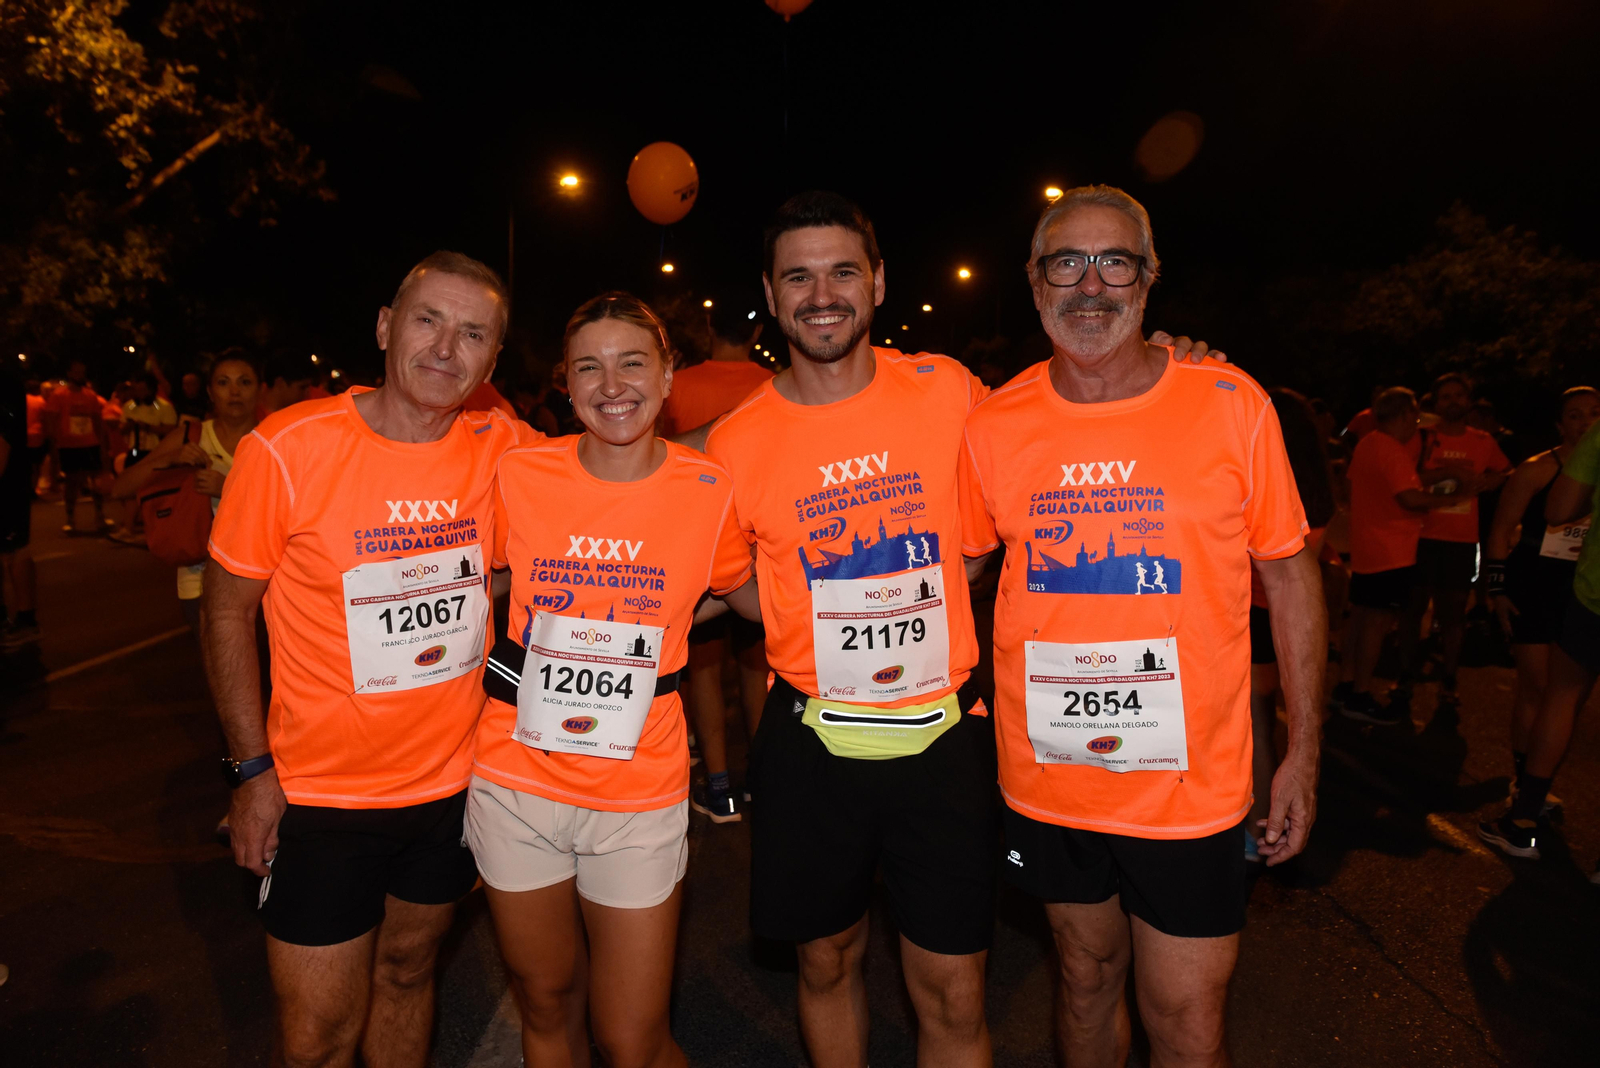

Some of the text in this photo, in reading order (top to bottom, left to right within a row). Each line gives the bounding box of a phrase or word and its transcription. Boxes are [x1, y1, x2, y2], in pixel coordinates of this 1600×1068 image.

[818, 451, 888, 487] XXXV
[1059, 460, 1136, 486] XXXV
[795, 472, 921, 508] CARRERA NOCTURNA
[806, 482, 923, 518] GUADALQUIVIR
[1030, 487, 1165, 502] CARRERA NOCTURNA
[386, 499, 458, 523] XXXV
[1036, 499, 1165, 515] GUADALQUIVIR
[354, 517, 476, 539] CARRERA NOCTURNA
[365, 528, 477, 553] GUADALQUIVIR
[565, 535, 643, 561] XXXV
[533, 558, 666, 577] CARRERA NOCTURNA
[429, 582, 462, 592] GUADALQUIVIR
[538, 570, 665, 591] GUADALQUIVIR
[1029, 583, 1045, 592] 2023
[379, 594, 466, 634] 12067
[893, 605, 922, 615] GUADALQUIVIR
[422, 631, 445, 642] JURADO
[447, 625, 468, 635] GARCÍA
[841, 617, 925, 650] 21179
[597, 657, 633, 665] GUADALQUIVIR
[540, 664, 633, 699] 12064
[916, 675, 943, 689] Cruzcampo
[542, 697, 622, 712] ALICIA JURADO OROZCO
[1063, 690, 1142, 716] 2654
[1050, 721, 1081, 729] MANOLO
[1122, 721, 1158, 729] DELGADO
[1139, 757, 1178, 765] Cruzcampo
